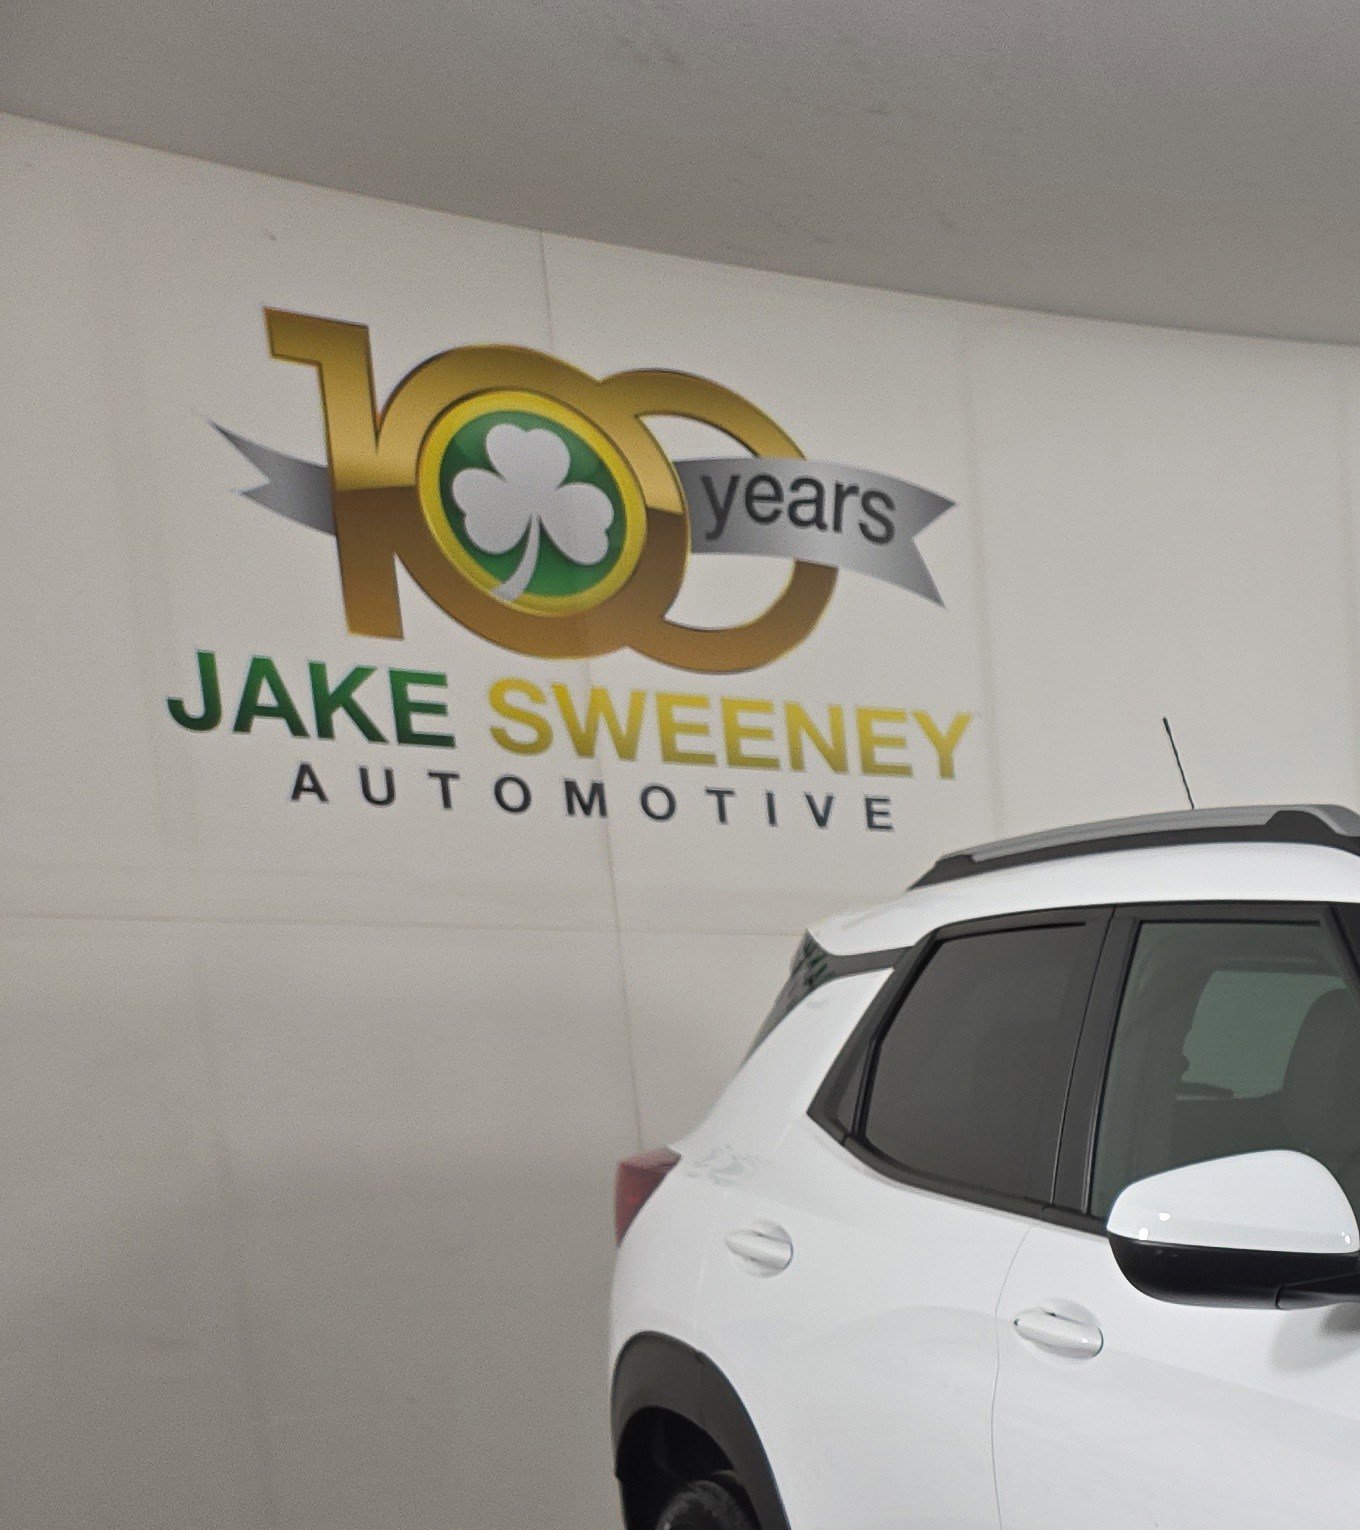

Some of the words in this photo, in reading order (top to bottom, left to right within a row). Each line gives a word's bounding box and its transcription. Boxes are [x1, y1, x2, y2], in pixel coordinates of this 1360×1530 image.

[262, 306, 839, 675] 100
[701, 468, 898, 545] years
[166, 649, 457, 749] JAKE
[487, 676, 973, 779] SWEENEY
[290, 762, 895, 831] AUTOMOTIVE
